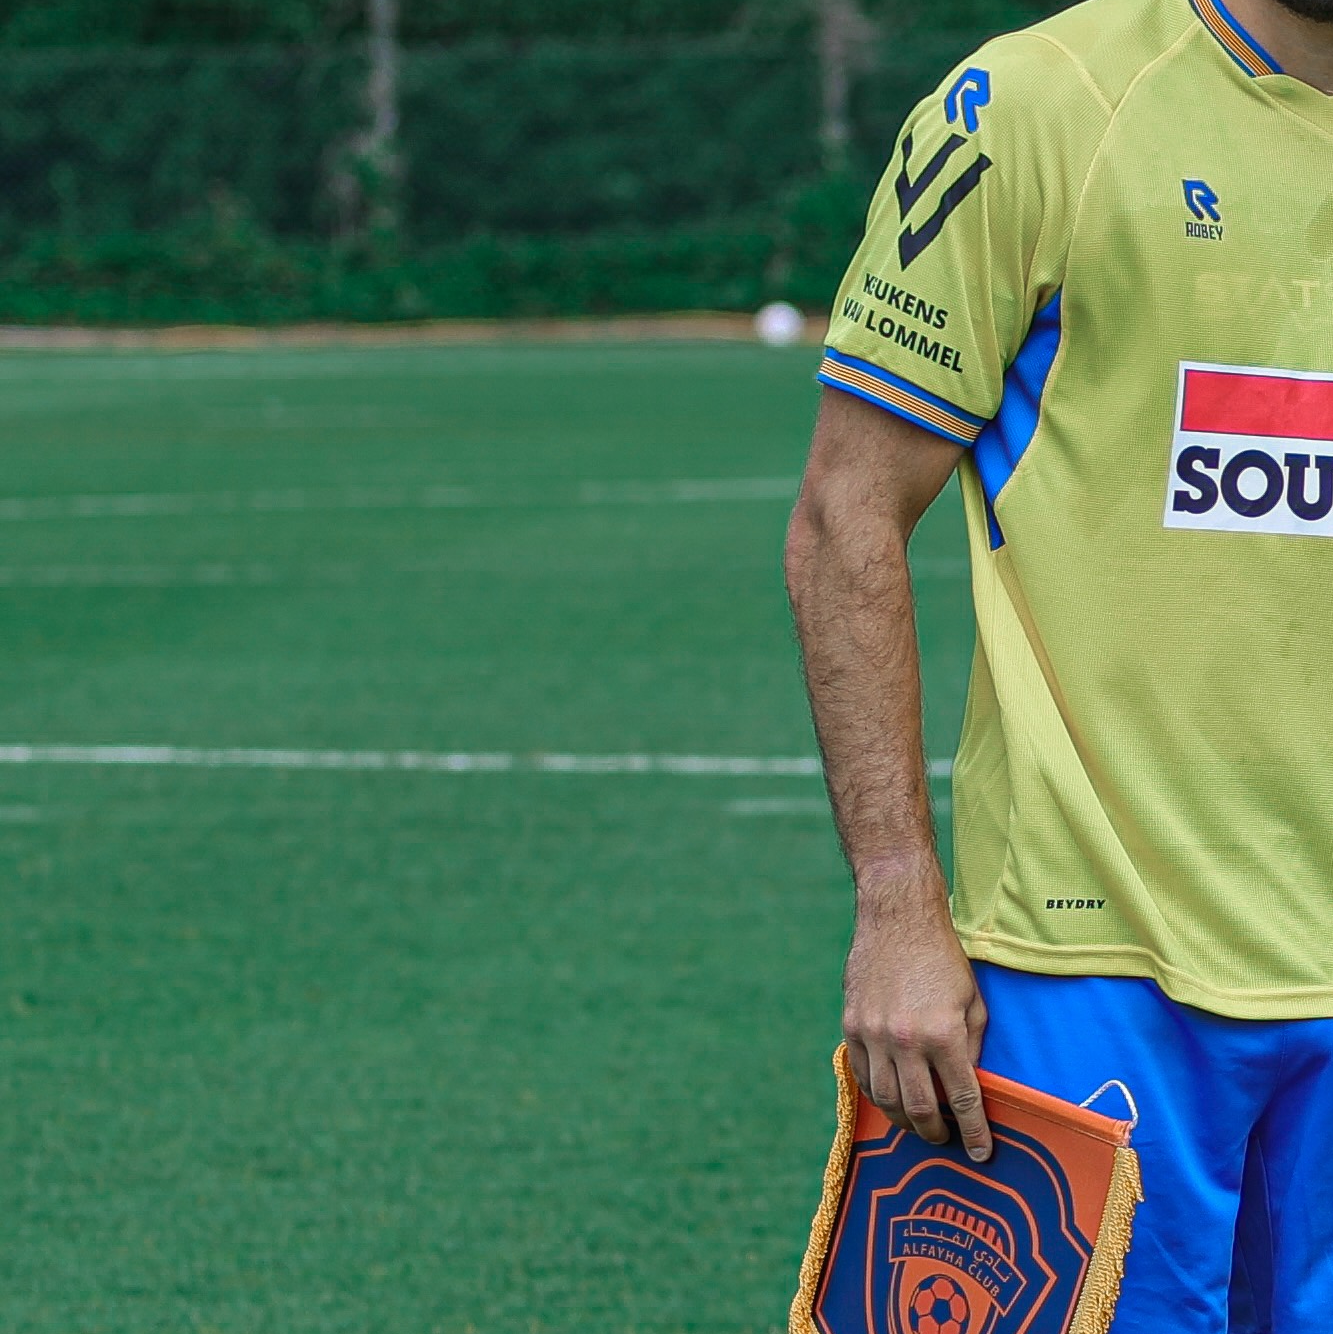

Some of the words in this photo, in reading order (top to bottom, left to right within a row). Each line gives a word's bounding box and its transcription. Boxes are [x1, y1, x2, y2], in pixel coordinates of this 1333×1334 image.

[1185, 221, 1223, 241] ROBEY
[865, 310, 963, 374] LOMMEL
[1046, 899, 1106, 909] BEYDRY
[903, 1243, 963, 1267] ALFAYHA
[968, 1264, 1000, 1297] CLUB
